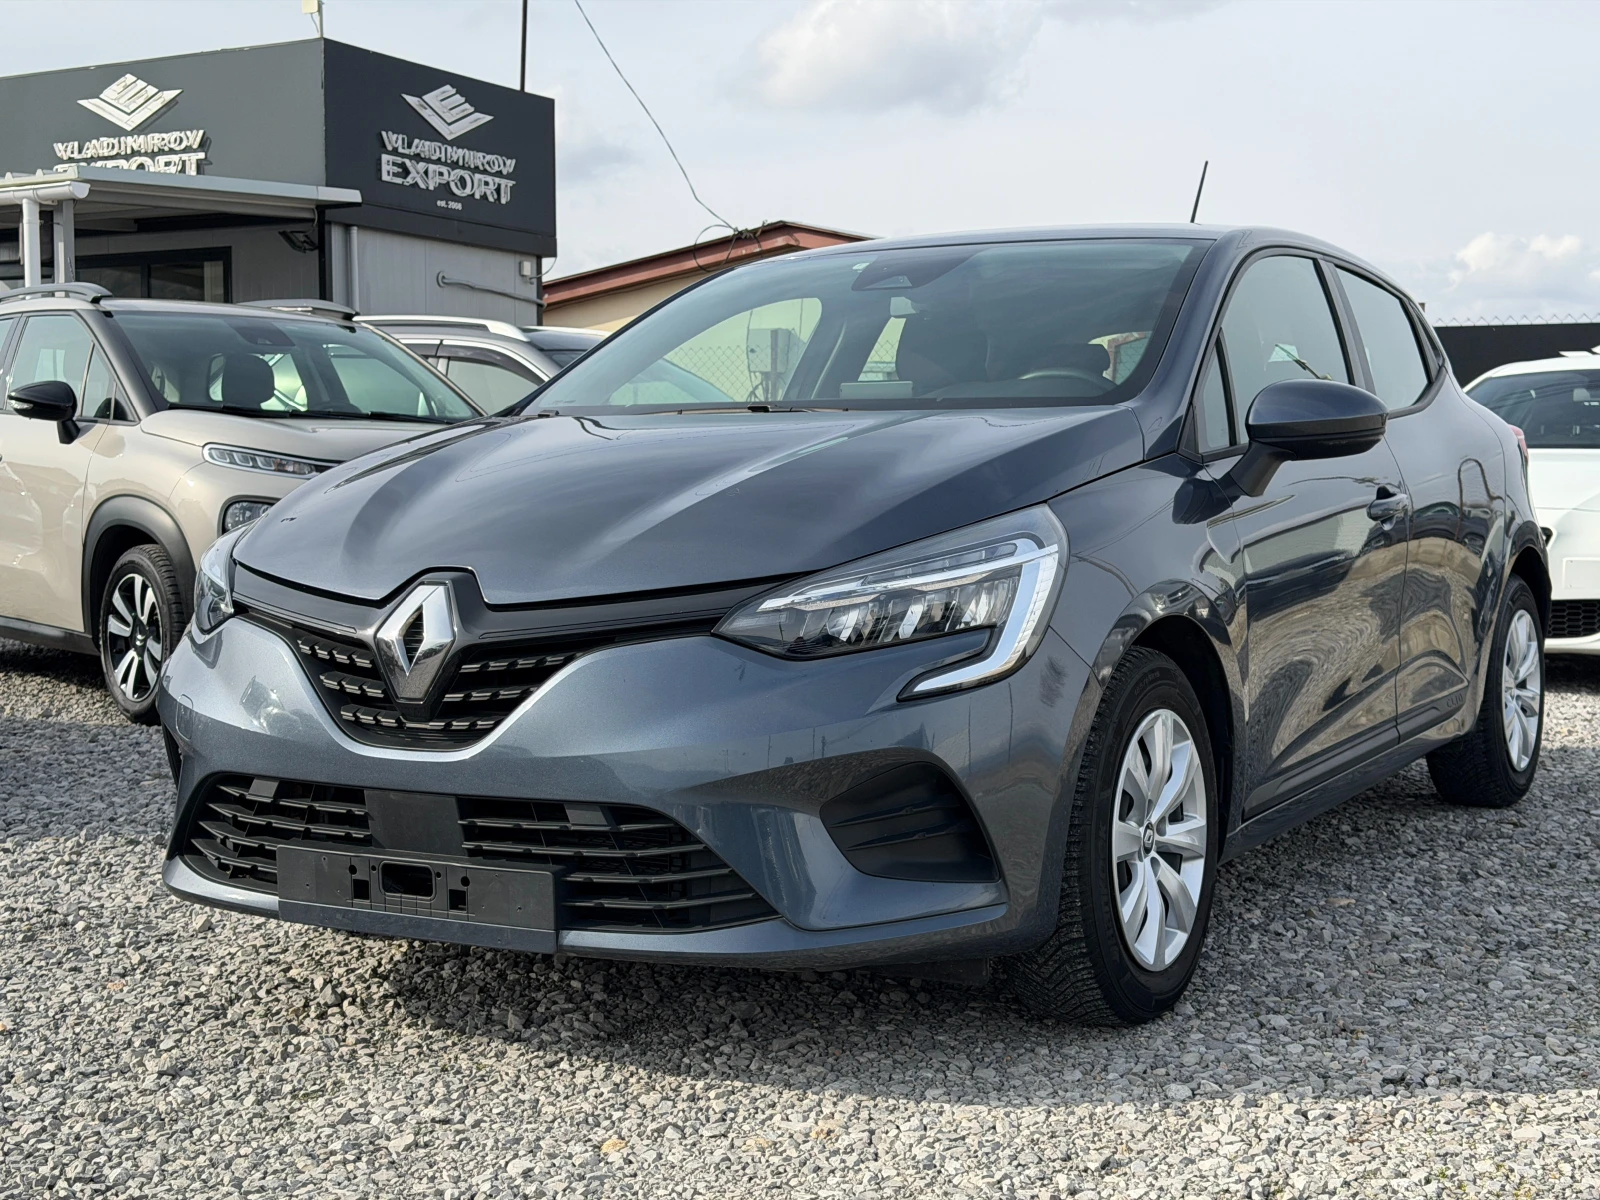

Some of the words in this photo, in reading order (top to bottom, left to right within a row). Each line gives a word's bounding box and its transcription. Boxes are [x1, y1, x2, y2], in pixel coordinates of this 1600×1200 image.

[53, 129, 205, 160] VLADIMIROV
[381, 131, 516, 175] VLADIMIROV
[53, 152, 206, 176] ORT
[381, 153, 516, 205] EXPORT
